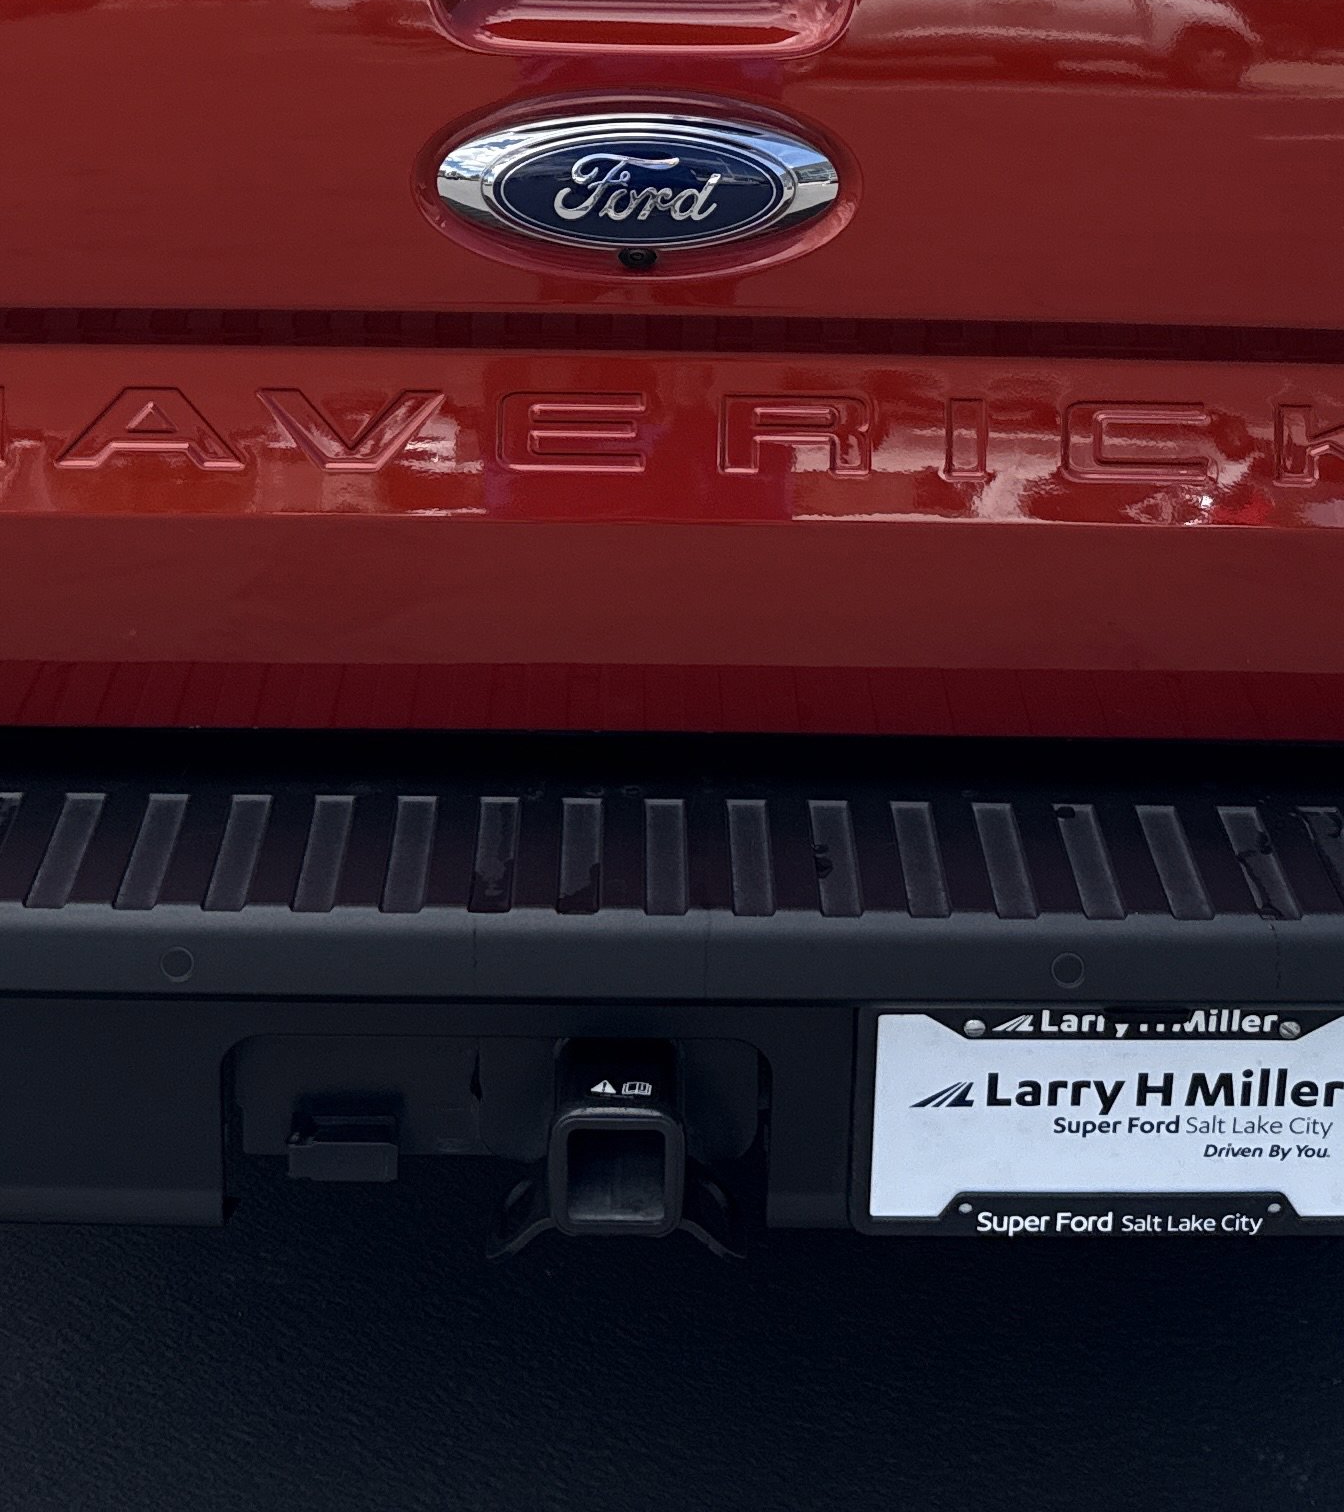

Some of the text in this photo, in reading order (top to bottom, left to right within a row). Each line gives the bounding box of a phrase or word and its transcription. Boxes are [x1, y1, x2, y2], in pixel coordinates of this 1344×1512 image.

[554, 152, 722, 221] Ford
[986, 1072, 1126, 1116] Larry
[1136, 1072, 1174, 1107] H
[1053, 1115, 1334, 1139] Super Ford Salt Lake City
[1203, 1144, 1331, 1161] Driven By You.
[976, 1211, 1264, 1237] Super Ford Salt Lake City
